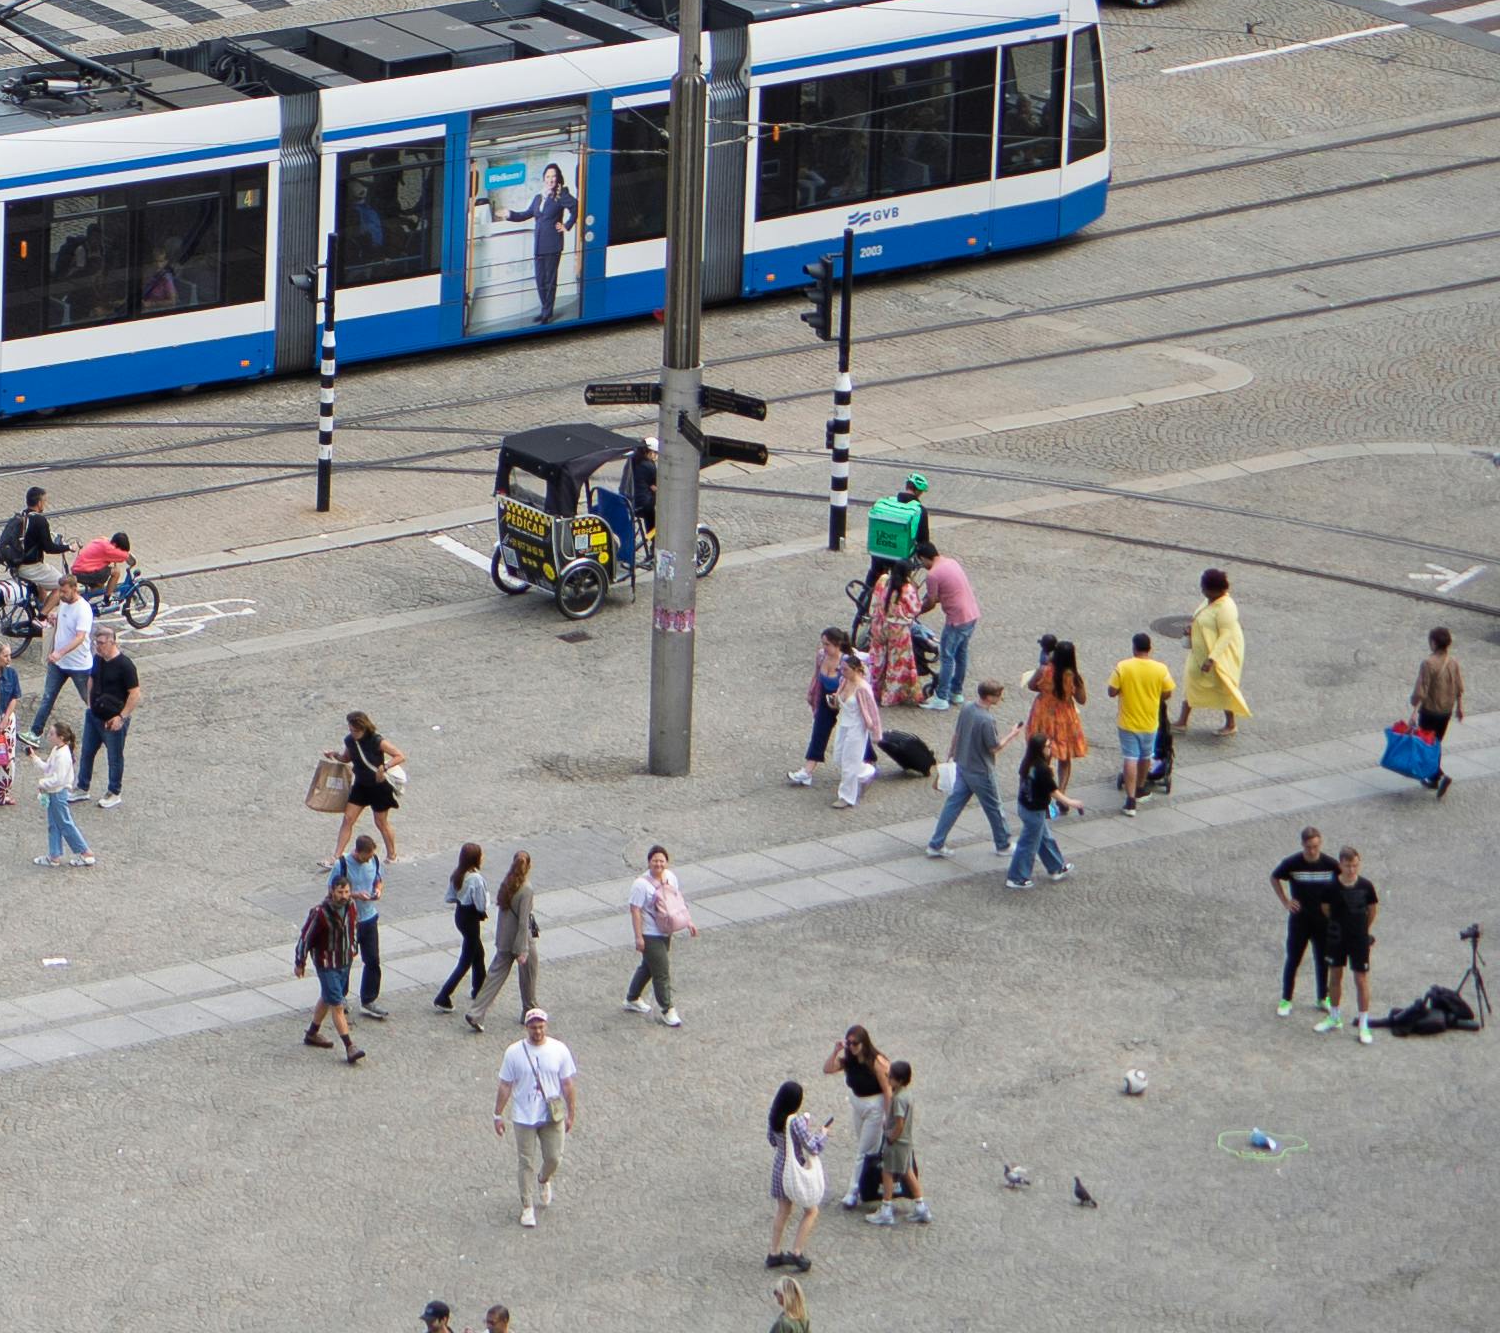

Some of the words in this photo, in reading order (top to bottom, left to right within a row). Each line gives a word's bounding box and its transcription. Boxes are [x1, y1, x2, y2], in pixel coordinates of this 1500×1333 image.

[243, 190, 254, 207] 4
[873, 207, 900, 222] GVB
[859, 245, 883, 258] 2003
[505, 512, 546, 537] PEDICAB
[572, 525, 602, 536] PEDICAB
[876, 530, 898, 540] Uber
